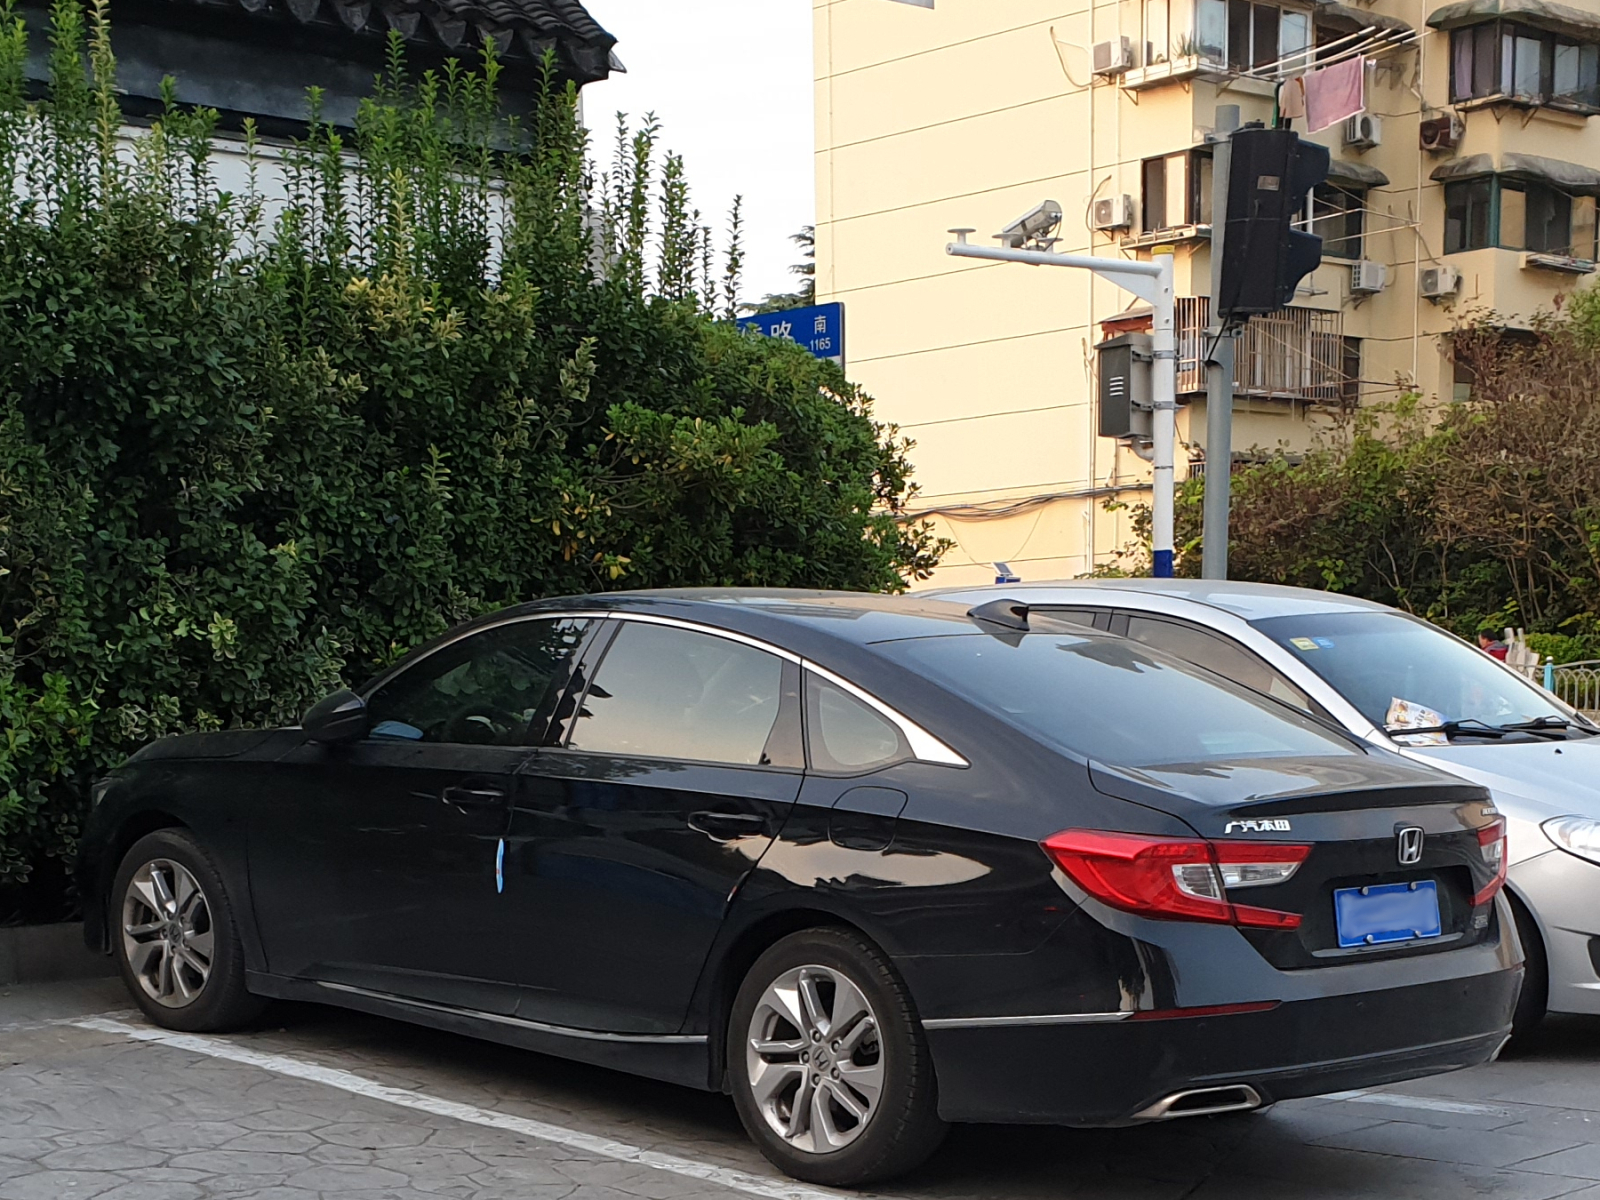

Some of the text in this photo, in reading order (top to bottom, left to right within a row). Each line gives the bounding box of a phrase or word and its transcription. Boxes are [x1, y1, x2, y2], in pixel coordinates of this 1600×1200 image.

[814, 315, 826, 335] 南
[810, 337, 831, 351] 1165
[1224, 819, 1291, 834] 广汽本田
